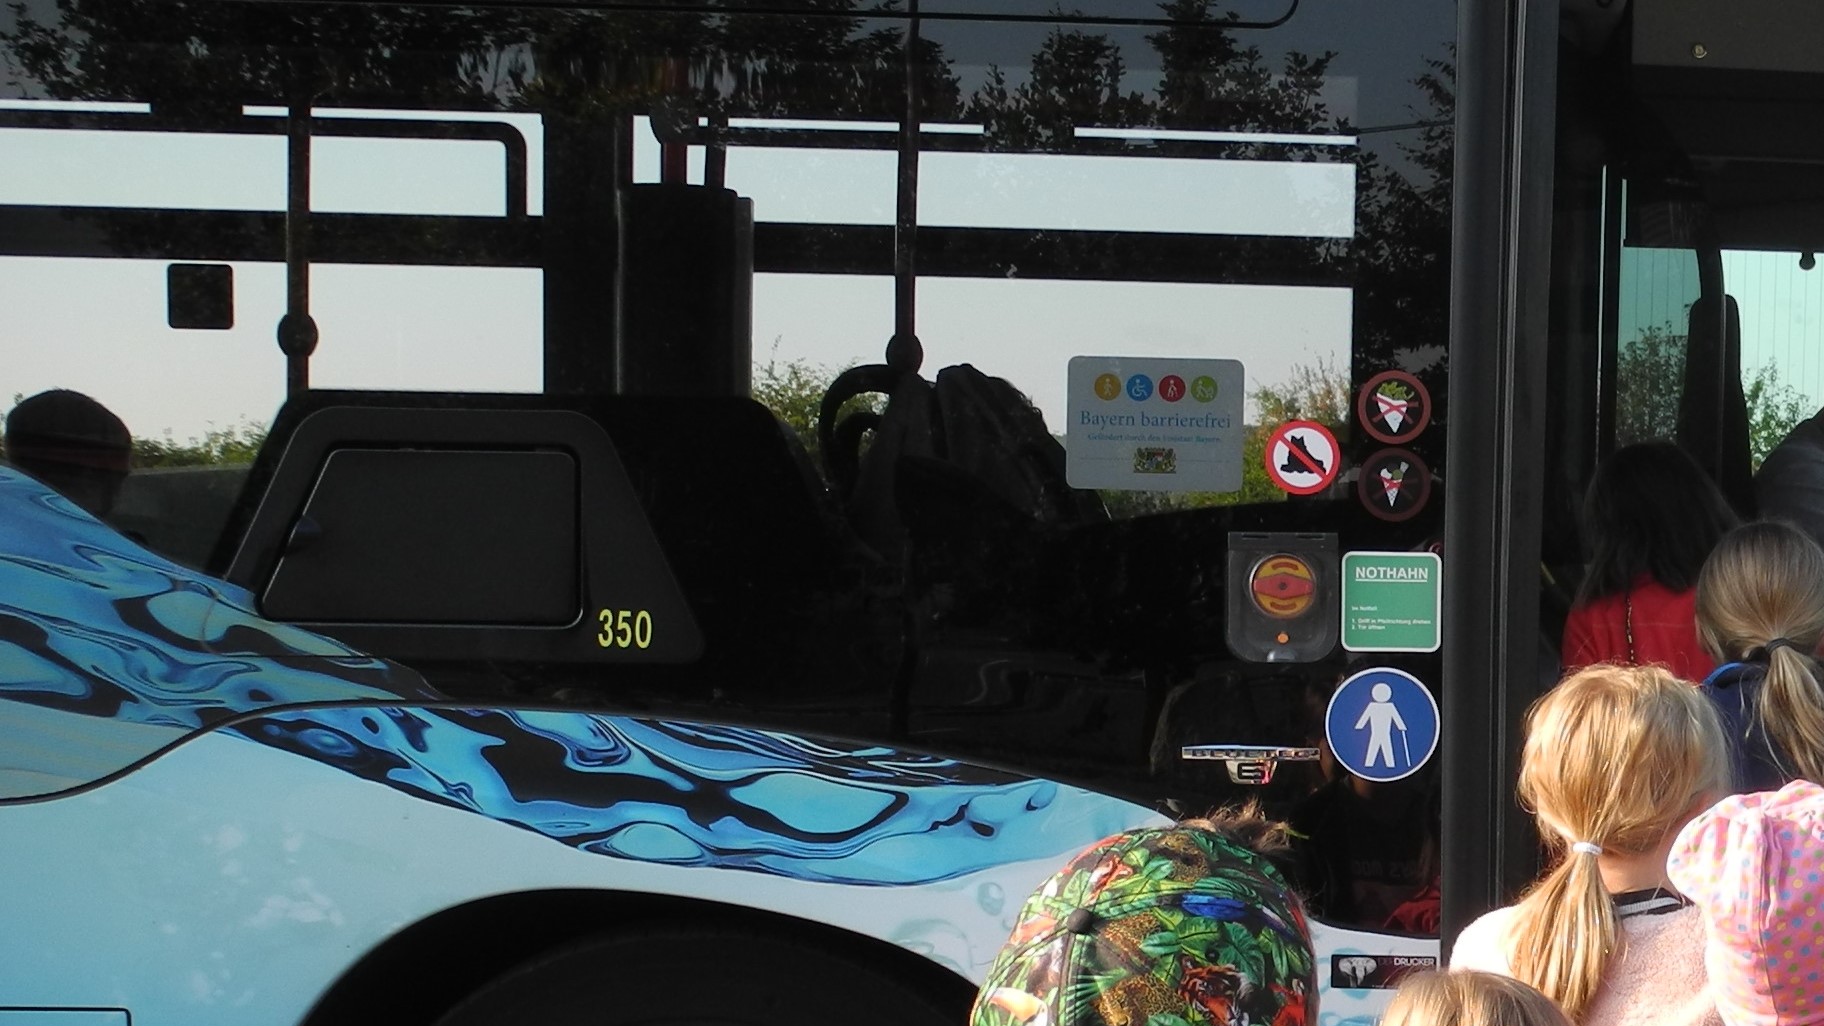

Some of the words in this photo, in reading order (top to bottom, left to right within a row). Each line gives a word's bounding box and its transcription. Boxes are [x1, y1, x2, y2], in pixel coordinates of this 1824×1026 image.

[1080, 410, 1135, 430] Bayern
[1141, 411, 1230, 429] barrierefrei
[1355, 566, 1428, 580] NOTHAHN
[598, 608, 652, 649] 350
[1393, 957, 1435, 966] DRUCKER
